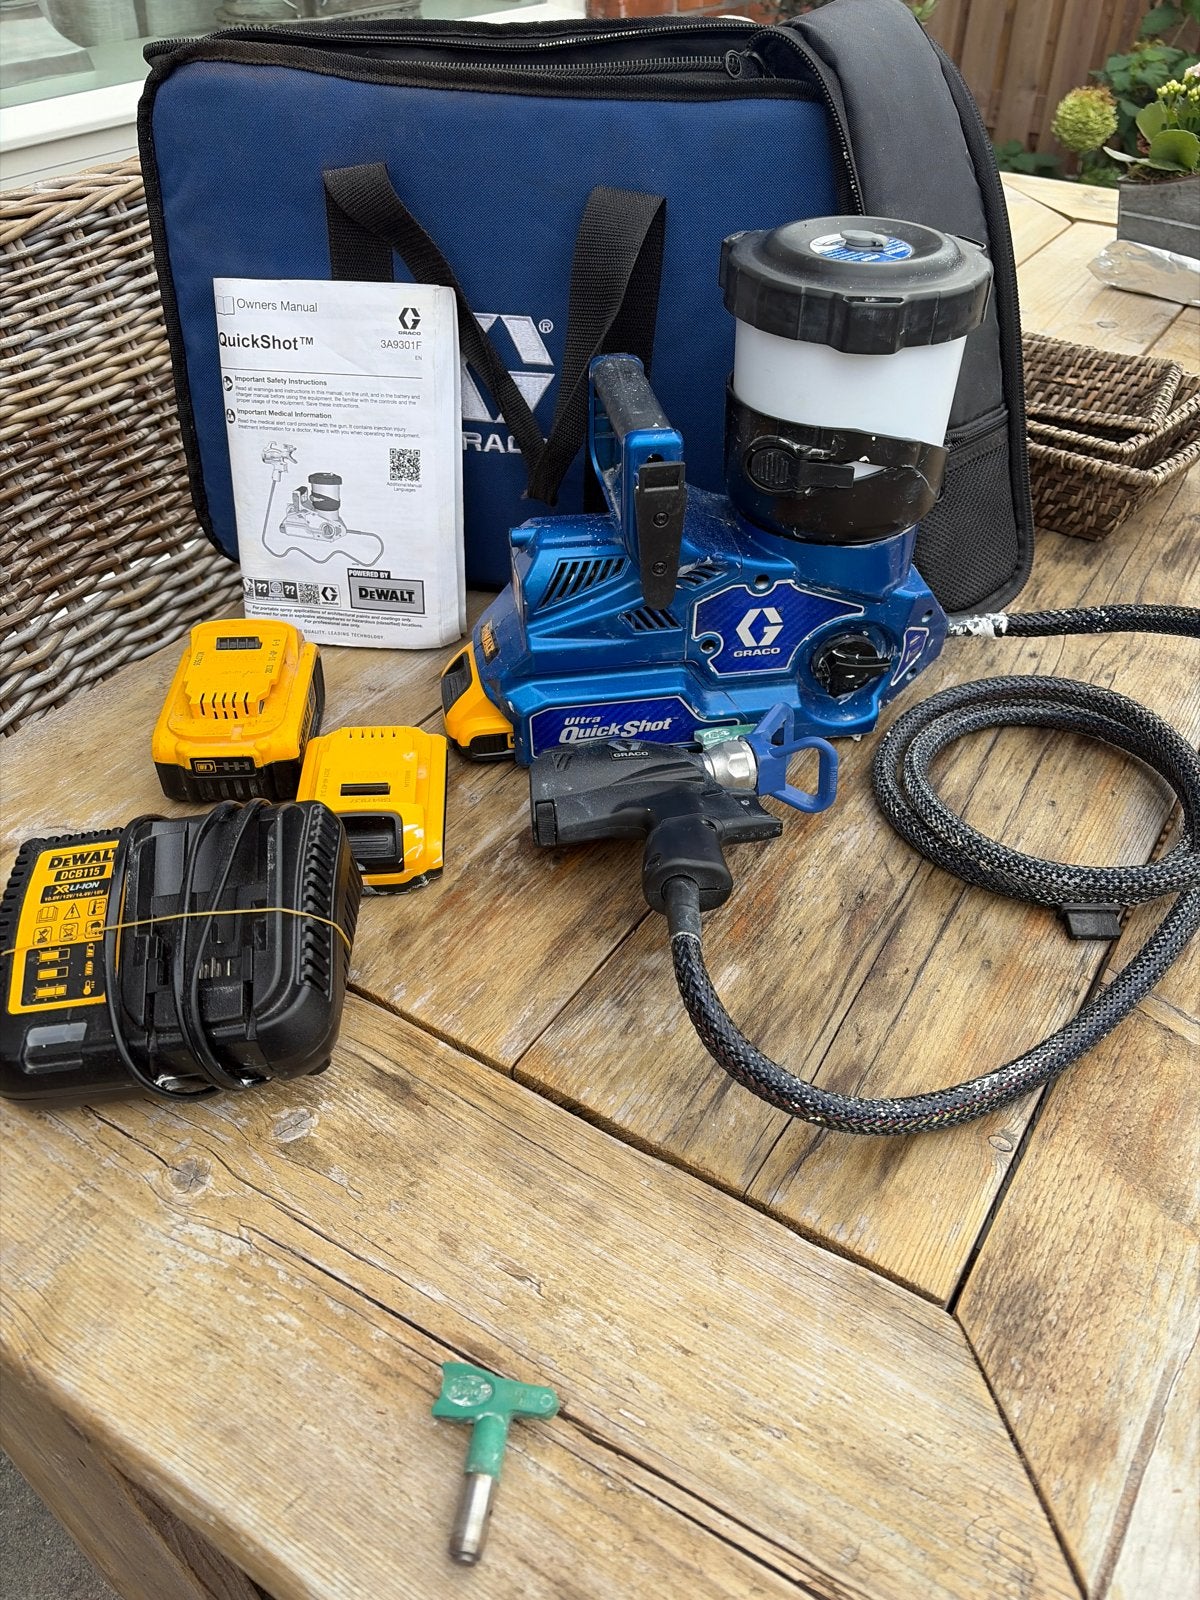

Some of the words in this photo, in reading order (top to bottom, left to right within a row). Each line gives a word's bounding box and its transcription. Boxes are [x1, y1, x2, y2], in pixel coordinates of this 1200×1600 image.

[237, 298, 277, 310] Owners
[280, 301, 318, 312] Manual
[380, 340, 422, 350] 3A9301F
[234, 375, 266, 384] Important
[266, 377, 287, 385] Safety
[288, 378, 328, 386] Instructions
[236, 408, 267, 416] Important
[734, 648, 780, 657] GRACO
[564, 716, 600, 726] Ultra
[60, 867, 100, 880] DCB115
[53, 884, 70, 894] XR
[70, 881, 100, 891] LI-ION
